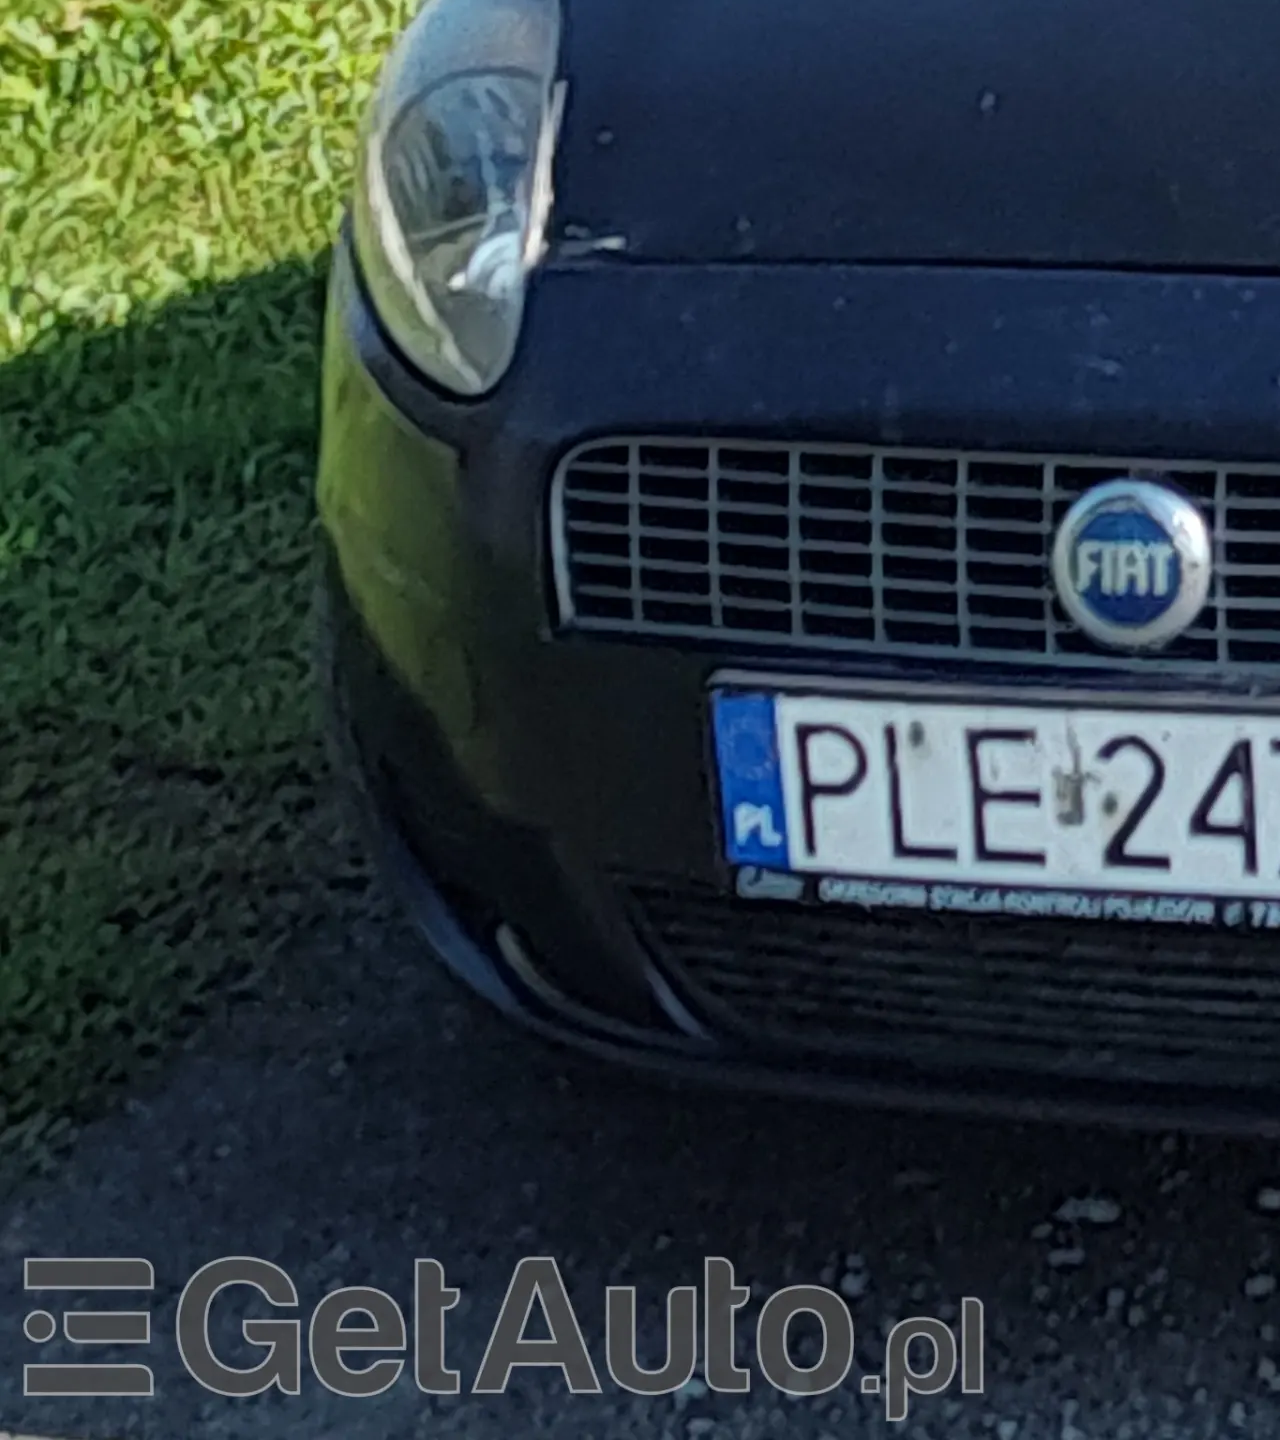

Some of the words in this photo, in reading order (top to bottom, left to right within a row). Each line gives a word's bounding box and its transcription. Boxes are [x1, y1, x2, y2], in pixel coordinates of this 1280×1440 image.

[1075, 538, 1174, 597] FIAT
[733, 800, 783, 847] PL
[794, 722, 1046, 866] PLE
